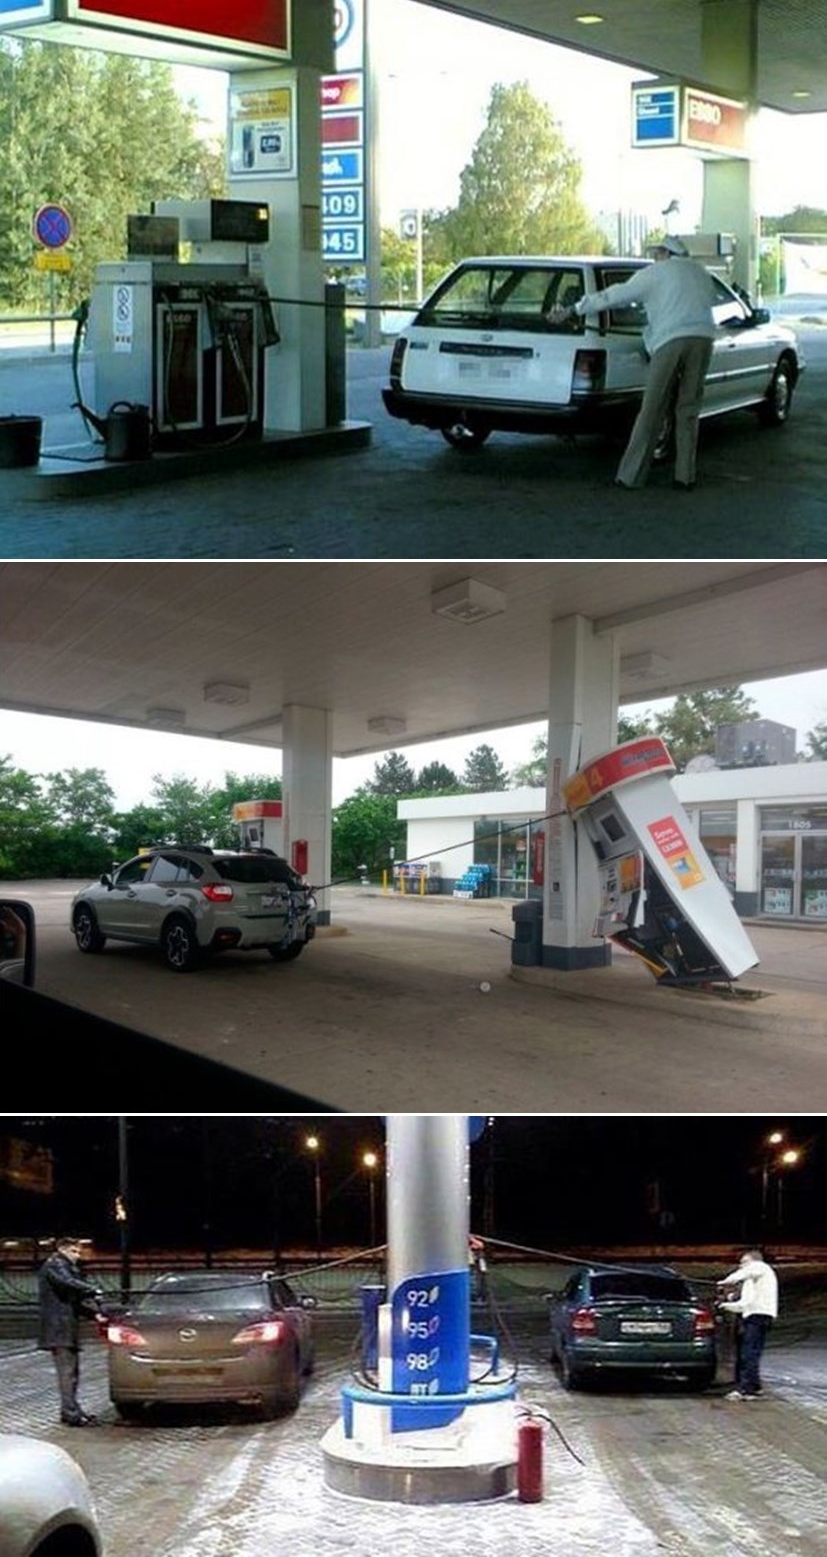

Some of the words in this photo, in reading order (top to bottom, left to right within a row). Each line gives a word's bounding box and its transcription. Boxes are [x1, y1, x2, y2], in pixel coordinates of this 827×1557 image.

[690, 98, 721, 127] ESSO
[407, 1290, 429, 1307] 92
[408, 1321, 429, 1339] 95
[406, 1353, 429, 1370] 98
